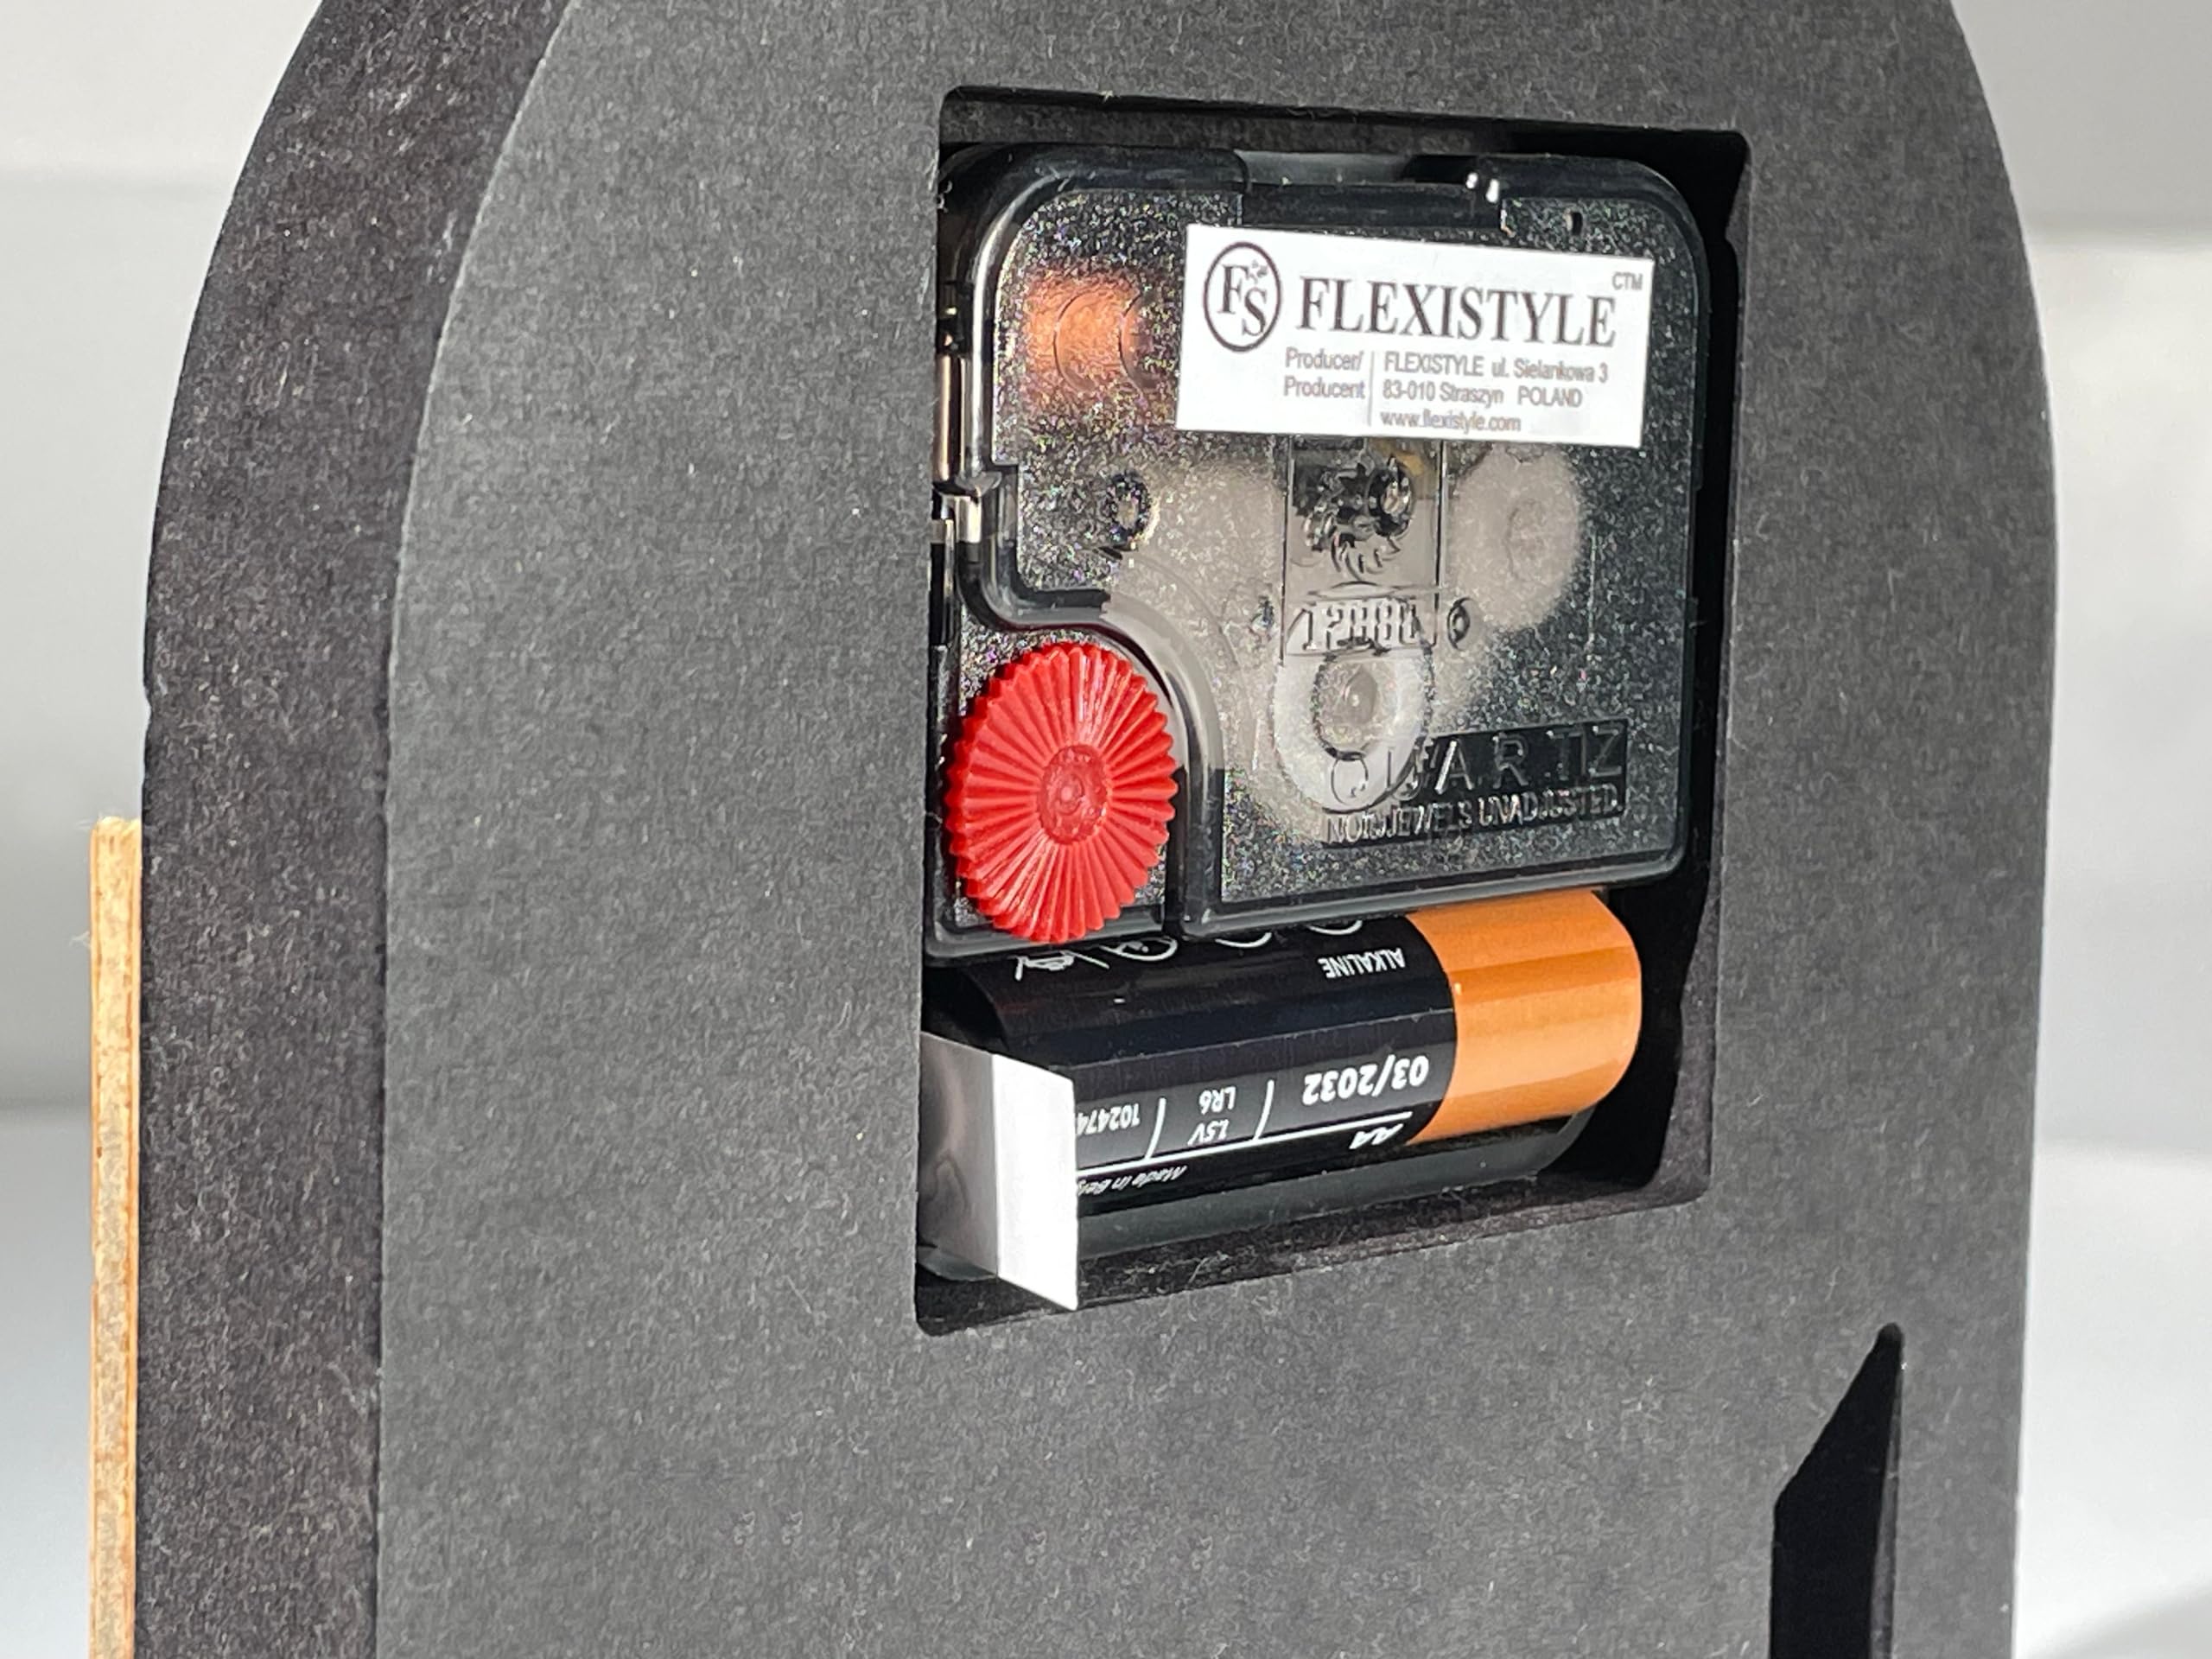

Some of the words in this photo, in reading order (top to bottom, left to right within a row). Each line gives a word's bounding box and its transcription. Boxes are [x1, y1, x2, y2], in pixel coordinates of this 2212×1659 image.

[1611, 270, 1643, 291] CTM
[1295, 275, 1617, 348] FLEXISTYLE
[1285, 346, 1364, 372] Producer/
[1384, 350, 1484, 377] FLEXISTYLE
[1491, 357, 1510, 378] ul.
[1513, 358, 1595, 383] Sielankowa
[1599, 361, 1609, 384] 3
[1283, 375, 1366, 400] Producent
[1382, 378, 1436, 401] 83-010
[1440, 381, 1504, 409] Straszyn
[1517, 385, 1583, 408] POLAND
[1380, 408, 1522, 434] www.flexistyle.com
[1318, 948, 1406, 978] ALKALINE
[1302, 1055, 1430, 1106] 03/2032
[1199, 1086, 1236, 1115] LR6
[1350, 1123, 1404, 1150] AA
